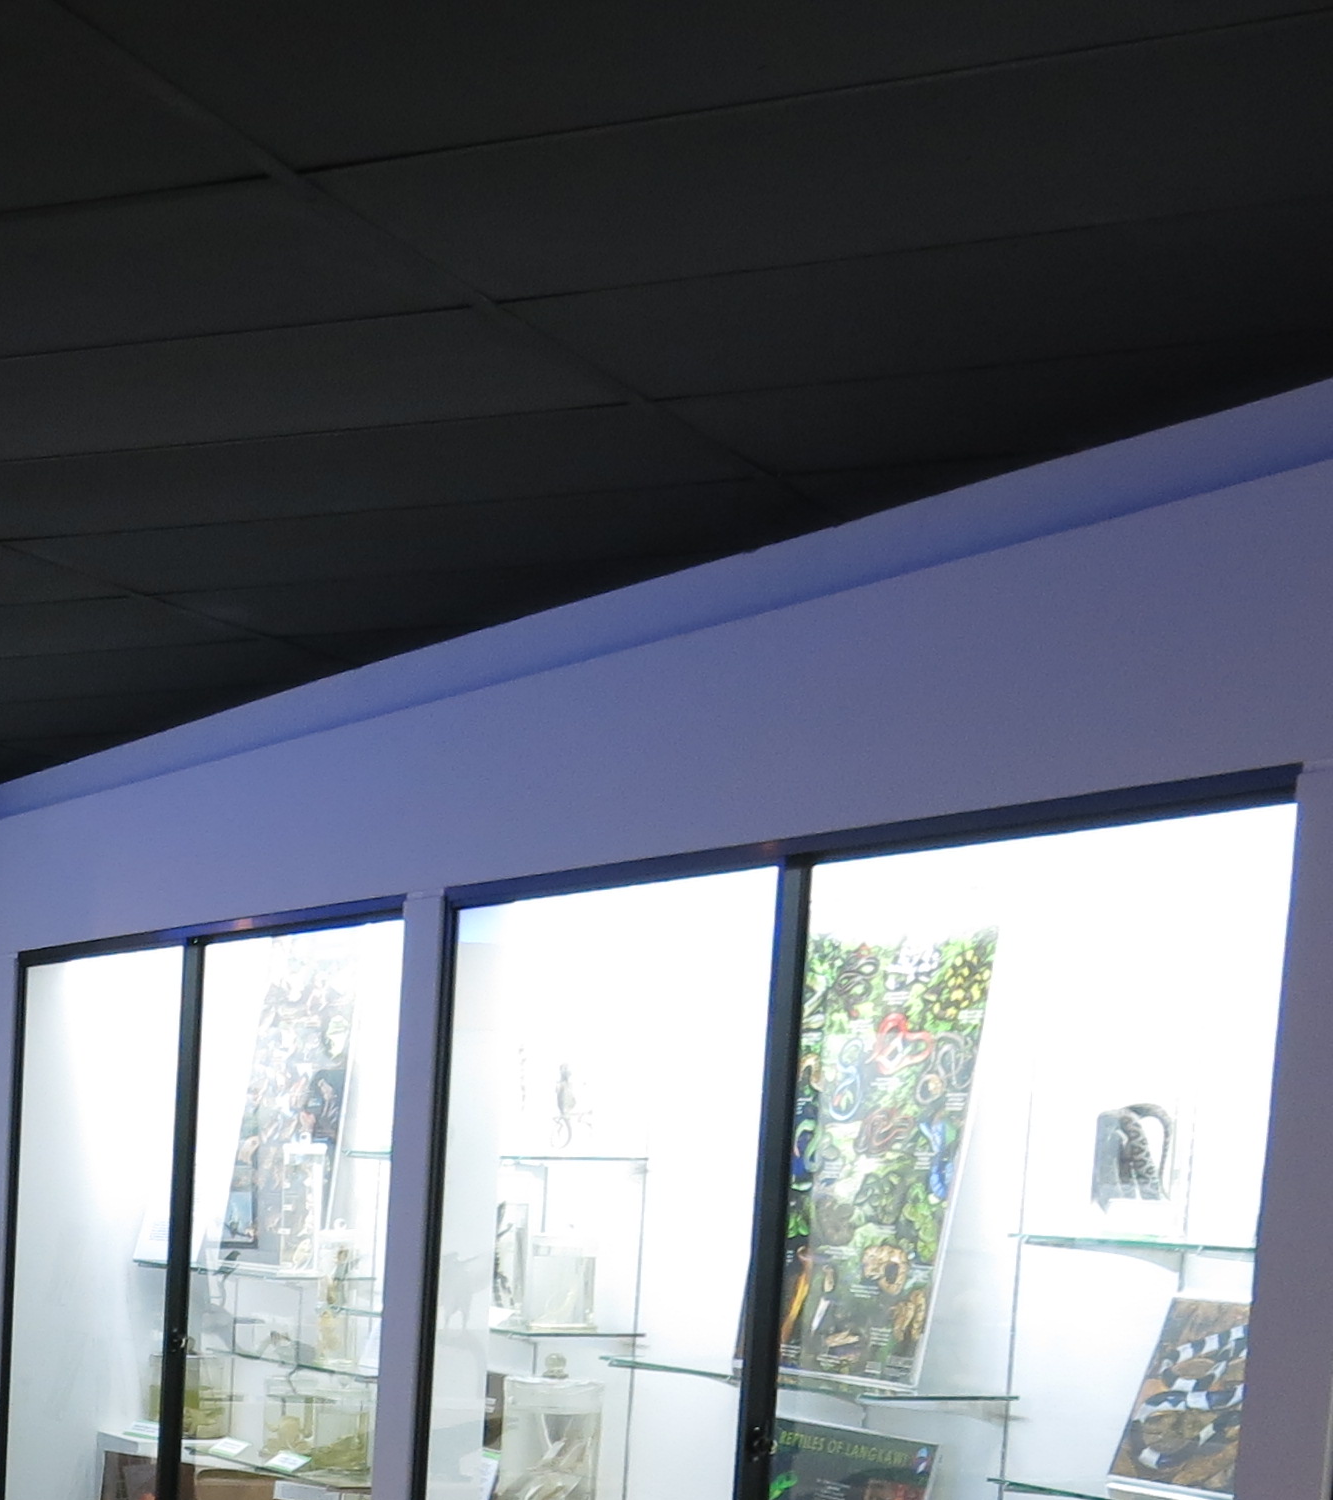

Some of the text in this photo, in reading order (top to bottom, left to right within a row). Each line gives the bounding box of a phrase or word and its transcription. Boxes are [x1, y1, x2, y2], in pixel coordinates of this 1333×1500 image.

[779, 1431, 909, 1466] REPTILES OF LANGKAWI
